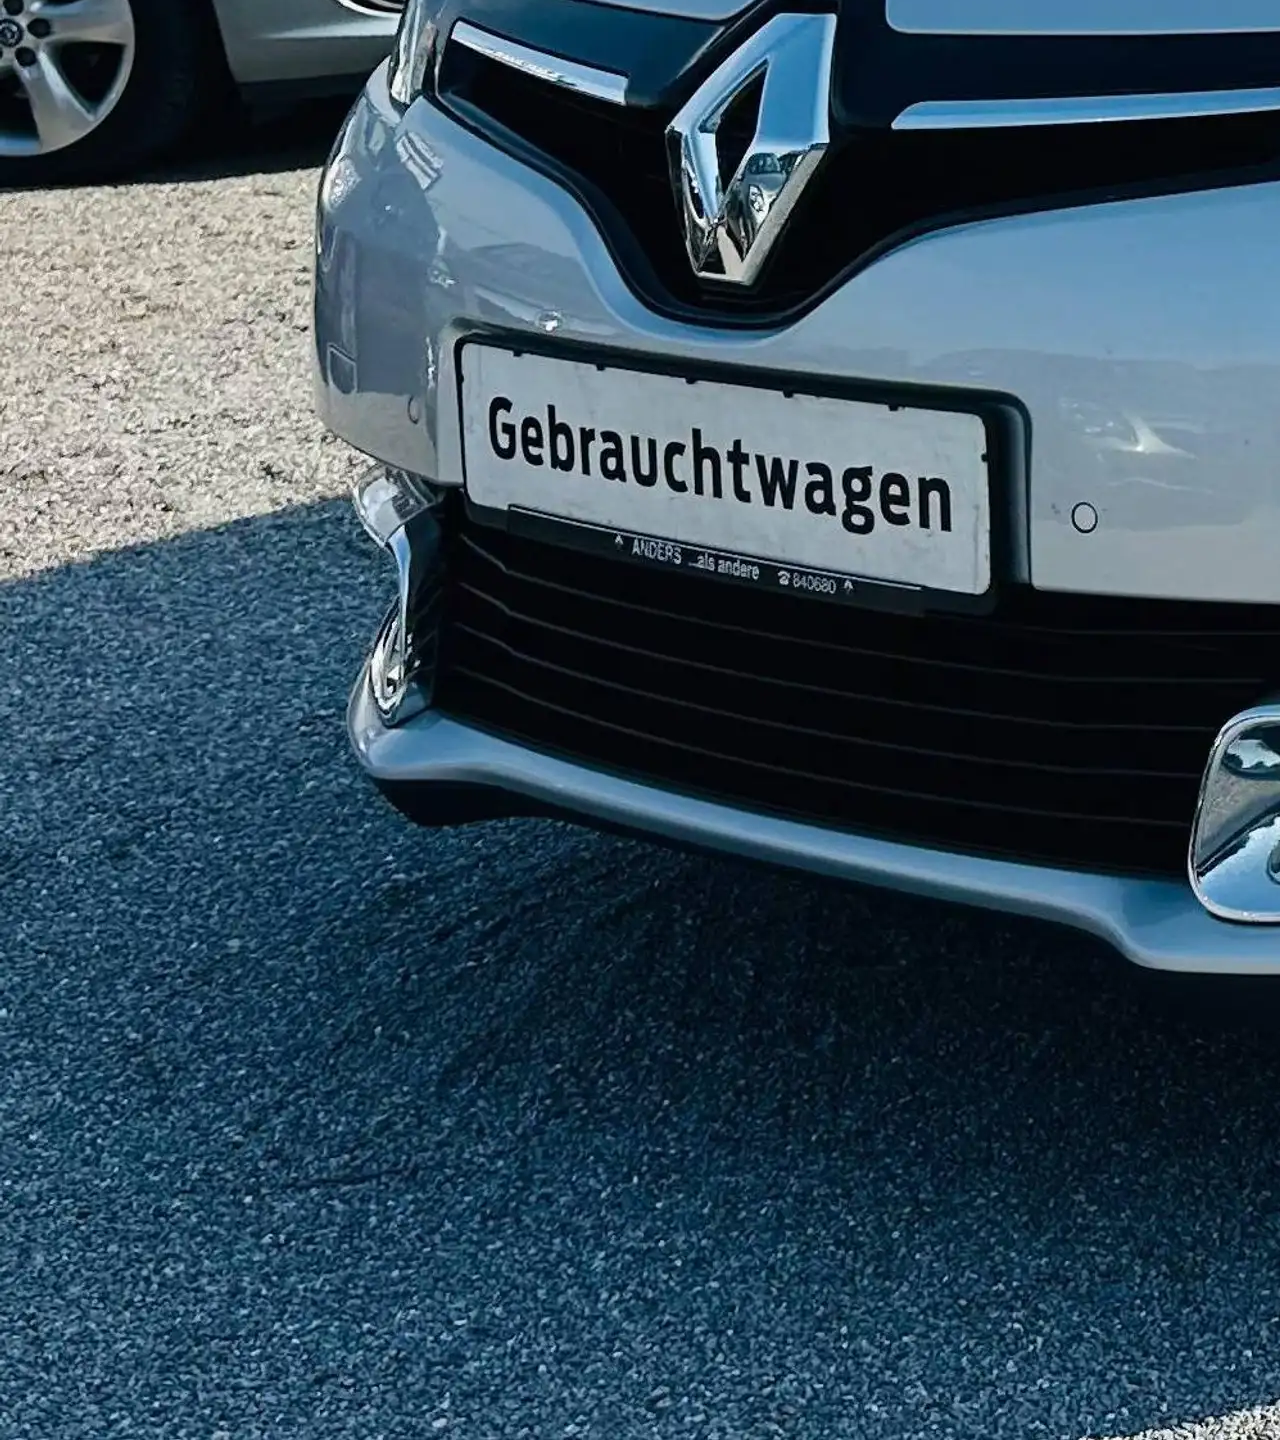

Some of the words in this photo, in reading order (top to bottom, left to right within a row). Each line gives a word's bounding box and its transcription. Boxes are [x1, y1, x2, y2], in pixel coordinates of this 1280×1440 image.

[488, 396, 952, 535] Gebrauchtwagen
[631, 539, 682, 565] ANDERS
[717, 559, 760, 581] andere
